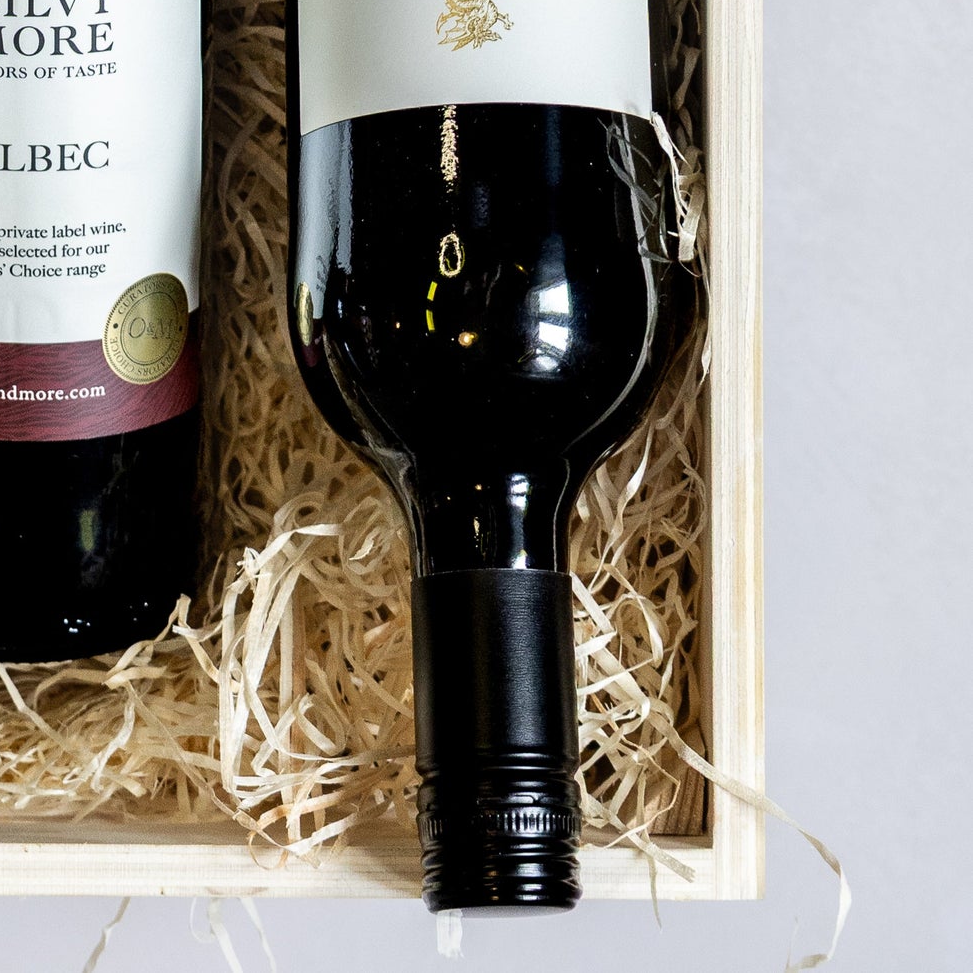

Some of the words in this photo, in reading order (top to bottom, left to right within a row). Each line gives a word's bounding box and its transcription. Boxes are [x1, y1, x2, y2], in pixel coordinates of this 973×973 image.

[34, 67, 57, 79] OF
[63, 62, 116, 77] TASTE
[52, 224, 85, 238] label
[90, 222, 126, 234] wine,
[0, 245, 57, 258] selected
[62, 244, 82, 257] for
[86, 244, 109, 255] our
[10, 264, 62, 277] Choice
[67, 265, 105, 278] range
[110, 337, 135, 373] CHOICE
